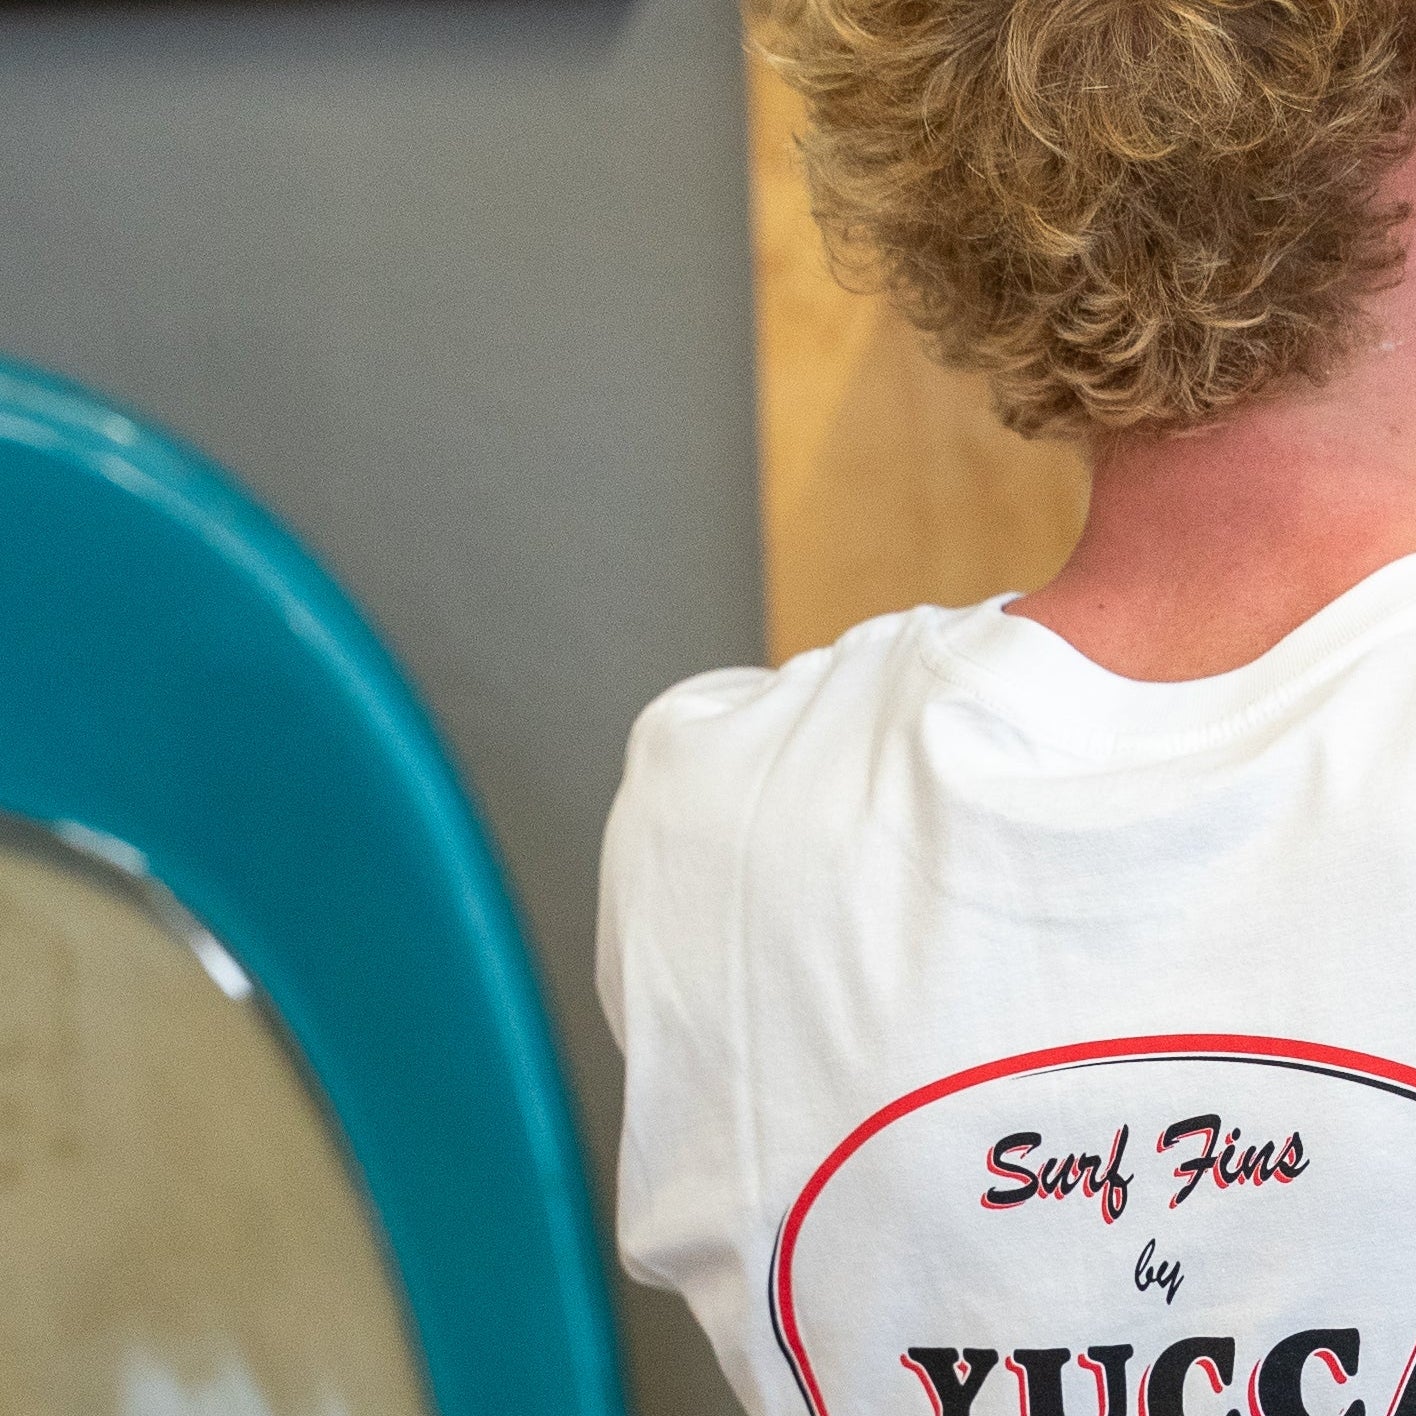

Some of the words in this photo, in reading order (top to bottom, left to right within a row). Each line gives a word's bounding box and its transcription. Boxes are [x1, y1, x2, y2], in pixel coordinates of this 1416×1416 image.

[980, 1124, 1134, 1225] Surf
[1156, 1113, 1310, 1209] Fins
[1134, 1239, 1183, 1303] by
